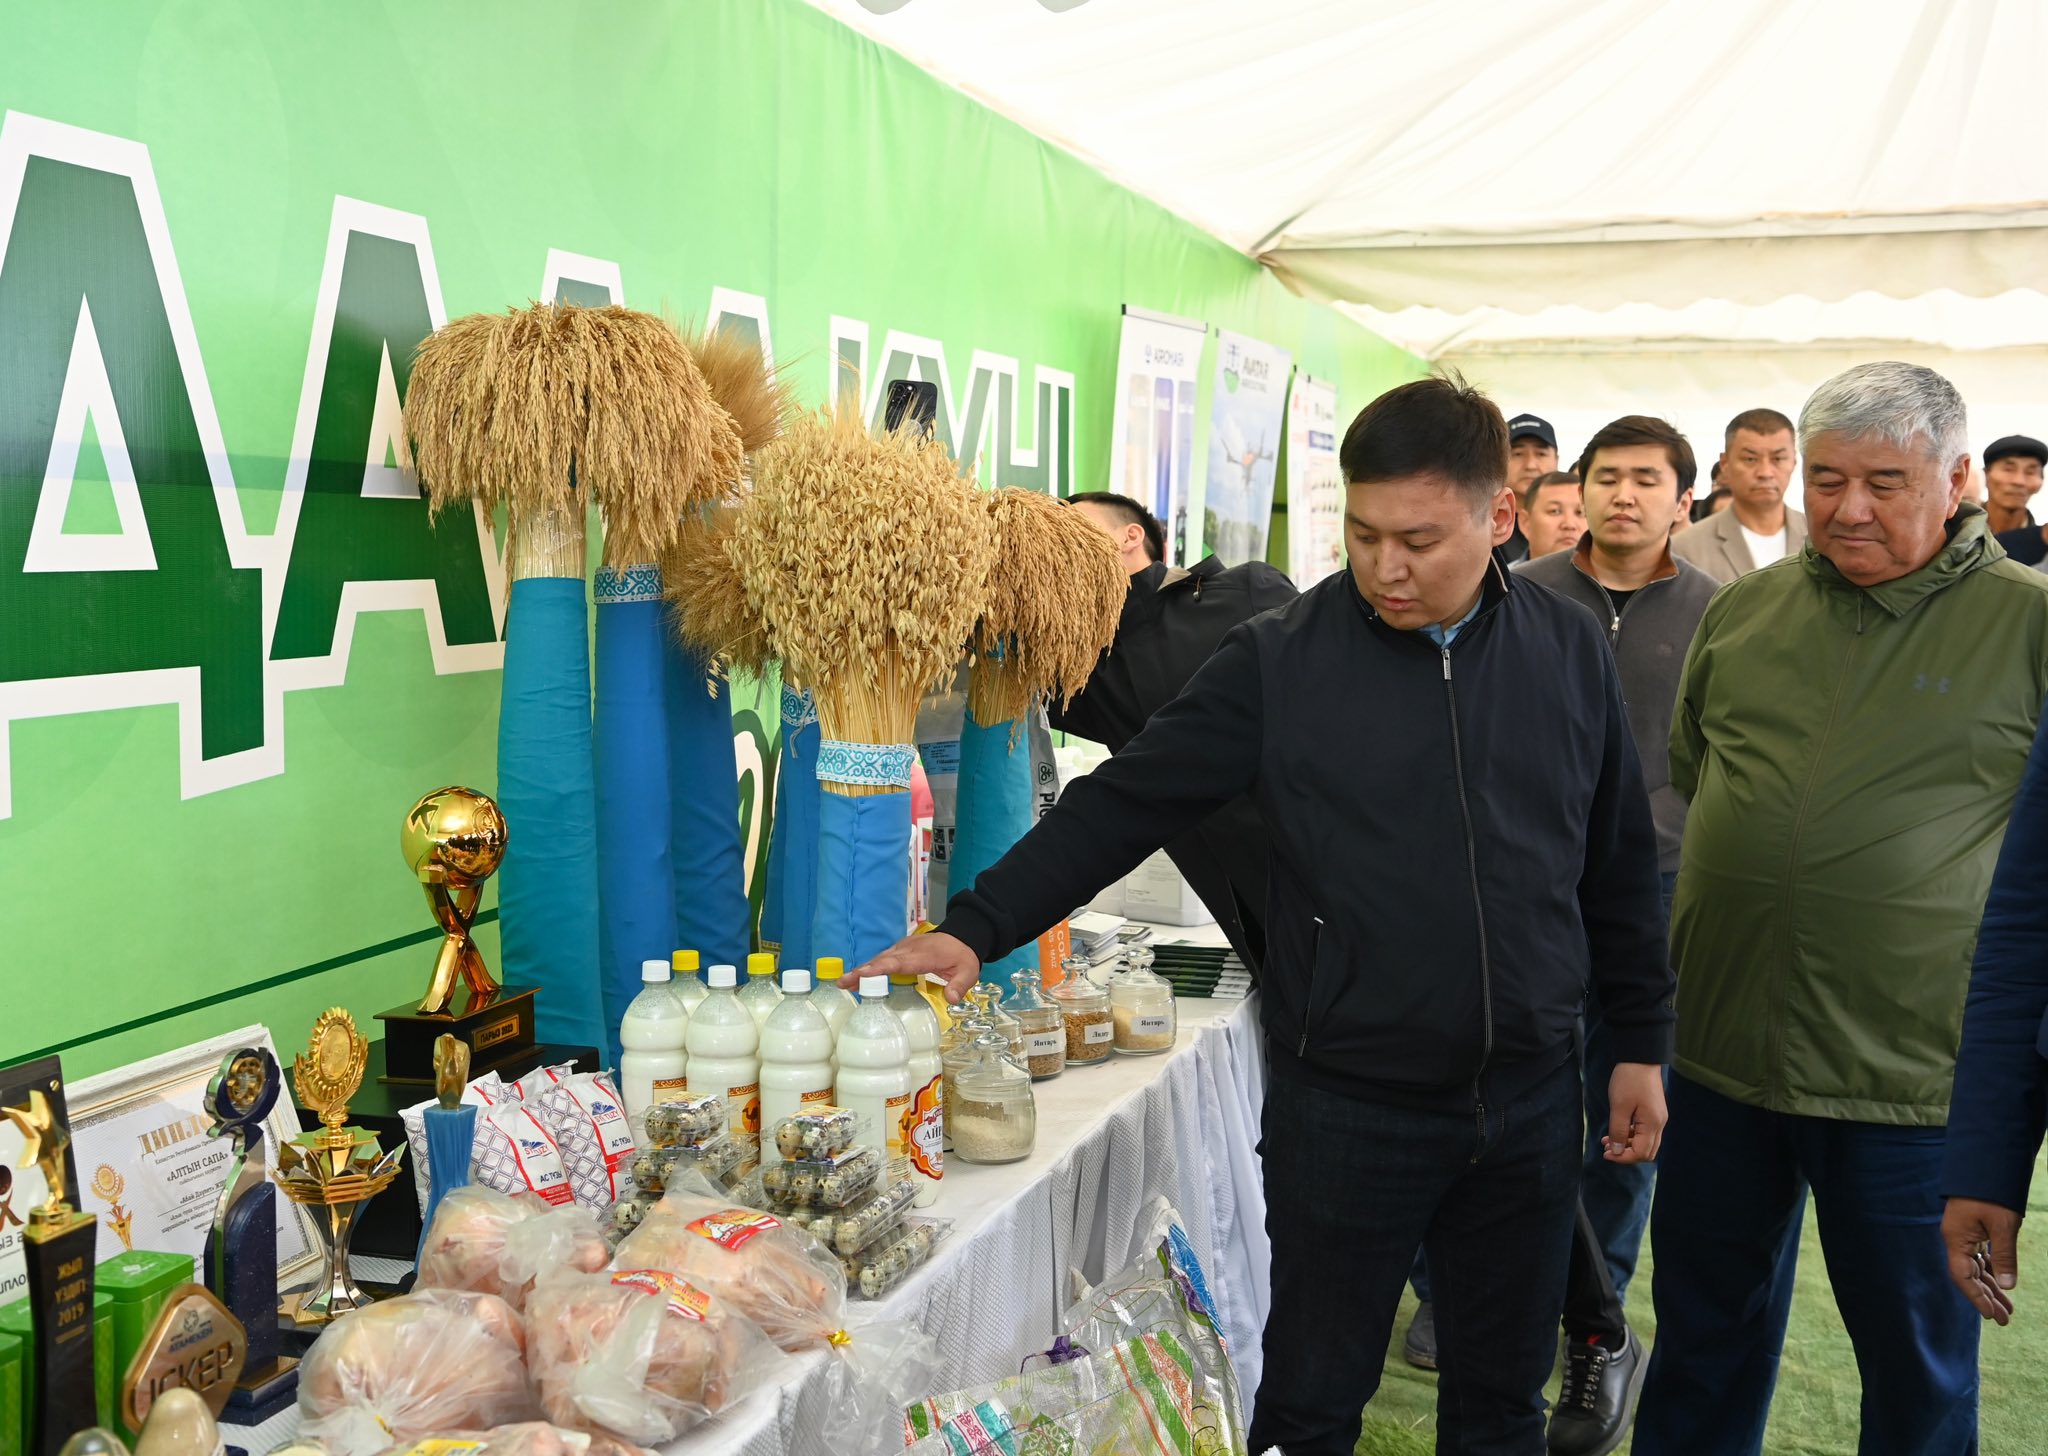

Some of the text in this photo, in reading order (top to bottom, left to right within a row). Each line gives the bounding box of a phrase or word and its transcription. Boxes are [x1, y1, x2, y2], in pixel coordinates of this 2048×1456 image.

[1140, 1018, 1165, 1028] Янтарь
[1033, 1038, 1057, 1048] Янтарь
[167, 1158, 201, 1183] «АЛТЫН
[202, 1151, 229, 1172] САПА»
